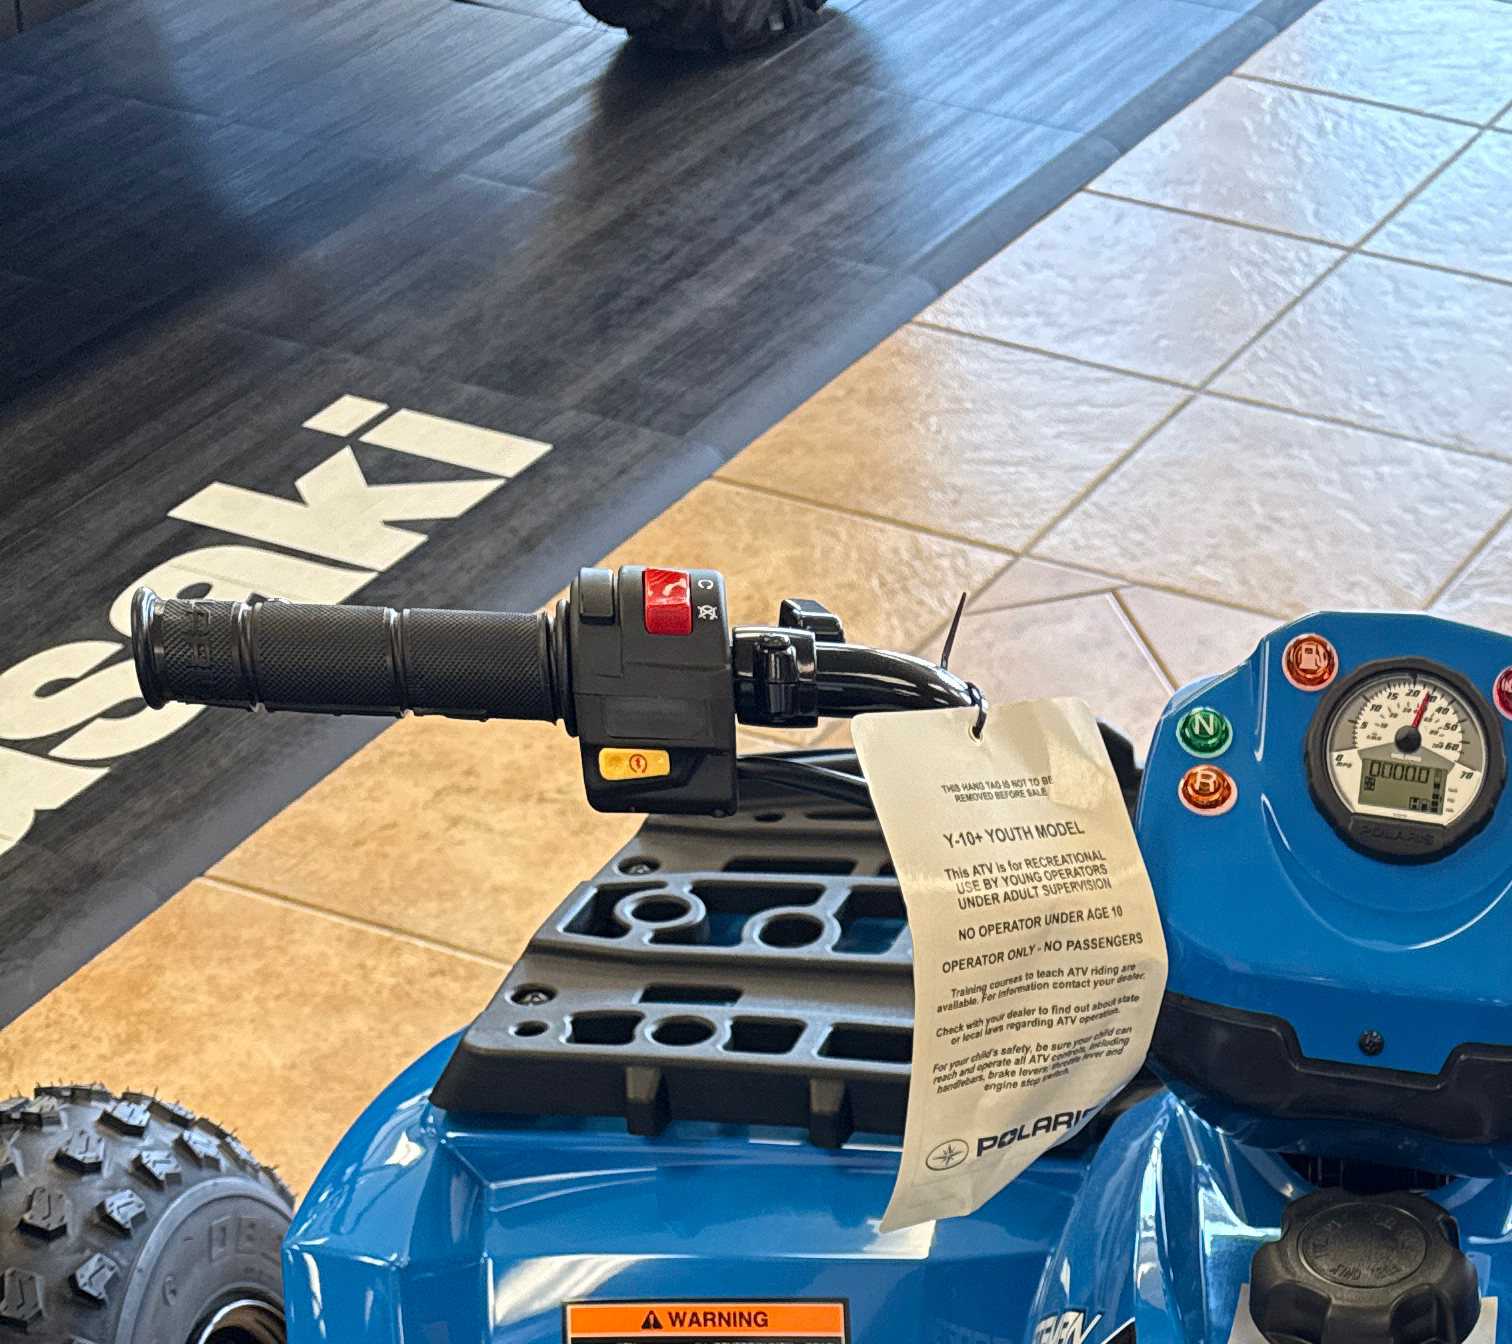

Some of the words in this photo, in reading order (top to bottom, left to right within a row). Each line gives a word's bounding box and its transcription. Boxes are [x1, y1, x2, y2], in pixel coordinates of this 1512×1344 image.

[1386, 692, 1399, 700] 15
[1405, 689, 1420, 697] 20
[1370, 704, 1381, 712] 10
[1435, 706, 1450, 715] 40
[1191, 713, 1217, 736] N
[1443, 723, 1458, 731] 50
[1445, 743, 1460, 751] 60
[1194, 770, 1218, 793] R
[1460, 771, 1473, 779] 70
[941, 784, 961, 794] THIS
[962, 783, 985, 792] HANG
[986, 781, 1001, 791] TAG
[1002, 780, 1010, 789] IS
[1011, 779, 1027, 789] NOT
[1028, 778, 1040, 787] TO
[955, 791, 994, 802] REMOVED
[995, 789, 1026, 800] BEFORE
[943, 833, 983, 849] Y-10+
[984, 826, 1034, 844] YOUTH
[1035, 820, 1085, 838] MODEL
[1360, 825, 1434, 845] POLARIS
[944, 866, 969, 881] This
[973, 863, 993, 877] ATV
[1009, 860, 1023, 871] for
[1024, 850, 1107, 869] RECREATIONAL
[956, 880, 981, 894] USE
[983, 877, 998, 891] BY
[1001, 870, 1043, 888] YOUNG
[1044, 864, 1108, 881] OPERATORS
[958, 893, 1000, 910] UNDER
[1003, 886, 1039, 903] ADULT
[1042, 877, 1112, 897] SUPERVISION
[958, 927, 975, 941] NO
[979, 916, 1042, 938] OPERATOR
[1045, 910, 1084, 926] UNDER
[1087, 907, 1110, 921] AGE
[1111, 905, 1123, 918] 10
[942, 952, 1005, 974] OPERATOR
[1007, 944, 1036, 961] ONLY
[1044, 940, 1062, 952] NO
[1066, 932, 1143, 951] PASSENGERS
[668, 1311, 769, 1328] WARNING
